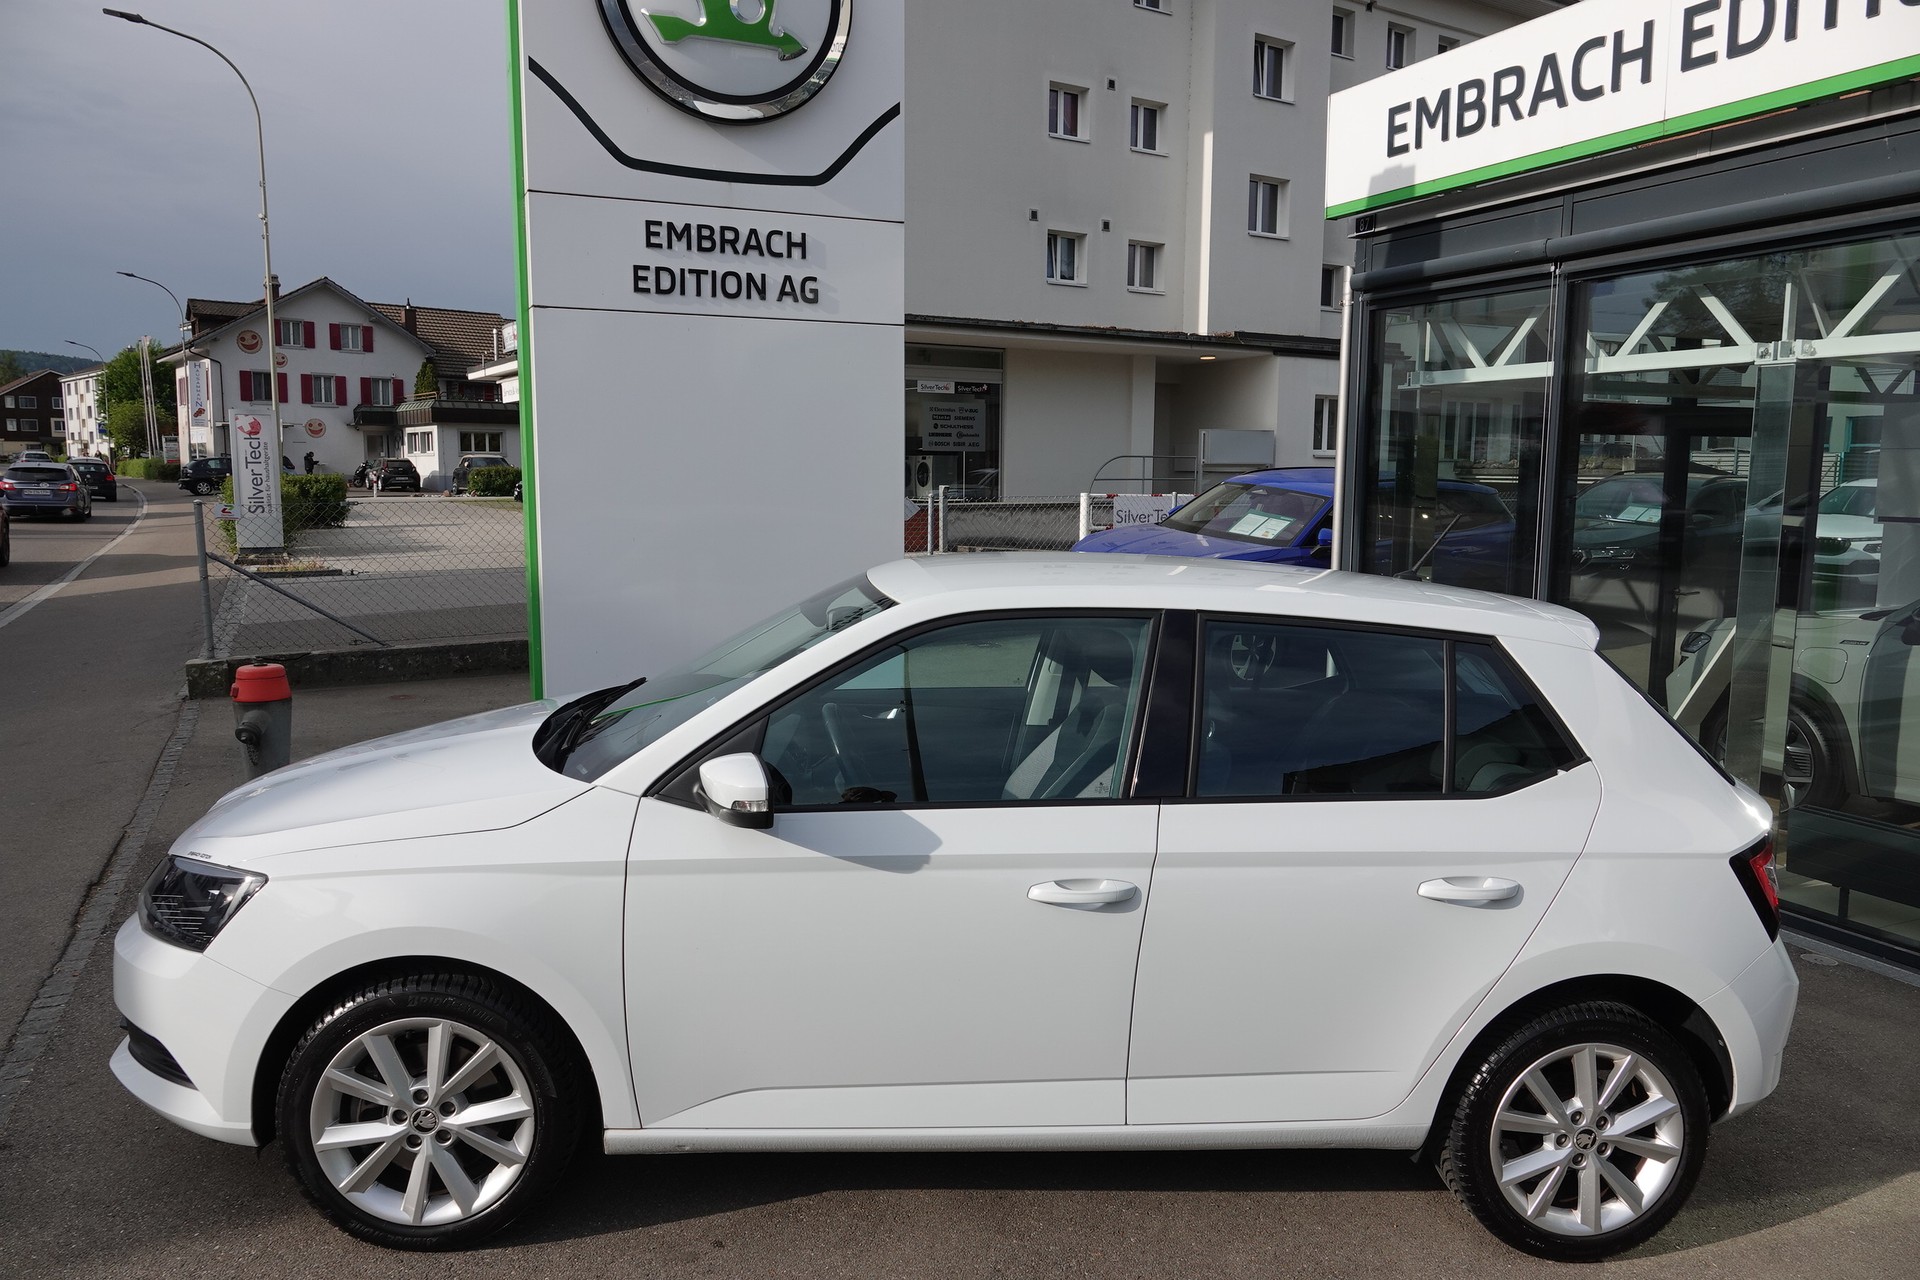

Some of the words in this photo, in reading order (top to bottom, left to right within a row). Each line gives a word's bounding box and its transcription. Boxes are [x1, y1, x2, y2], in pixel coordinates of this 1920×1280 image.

[1388, 20, 1654, 158] EMBRACH
[645, 219, 807, 260] EMBRACH
[1359, 217, 1370, 231] 87
[632, 264, 767, 301] EDITION
[776, 274, 819, 305] AG
